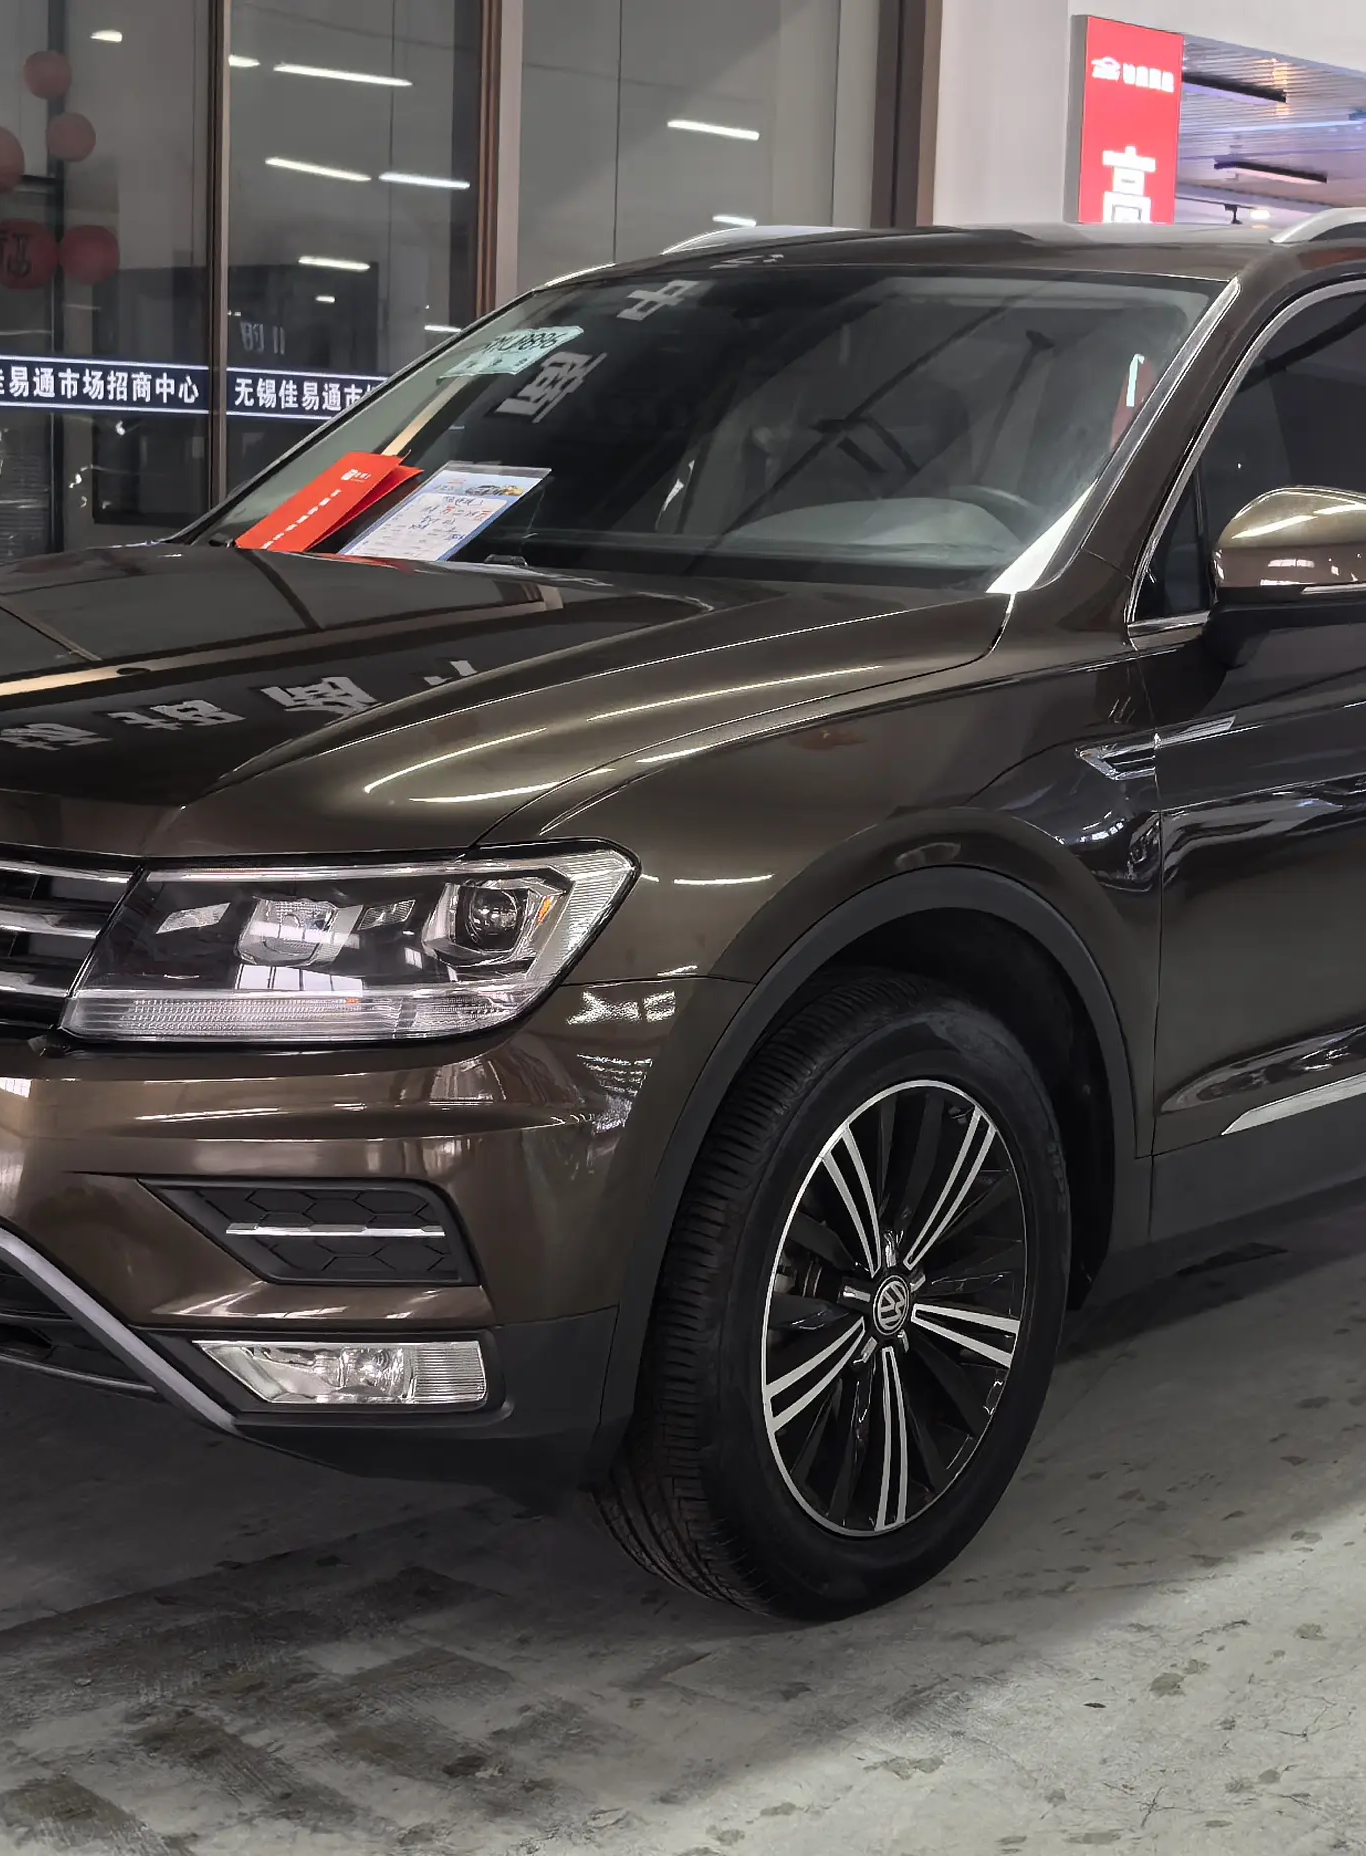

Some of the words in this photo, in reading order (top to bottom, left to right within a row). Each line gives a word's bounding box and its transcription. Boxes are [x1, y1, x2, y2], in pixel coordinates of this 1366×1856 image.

[1102, 146, 1156, 223] 高
[235, 377, 374, 412] 无锡佳易通市
